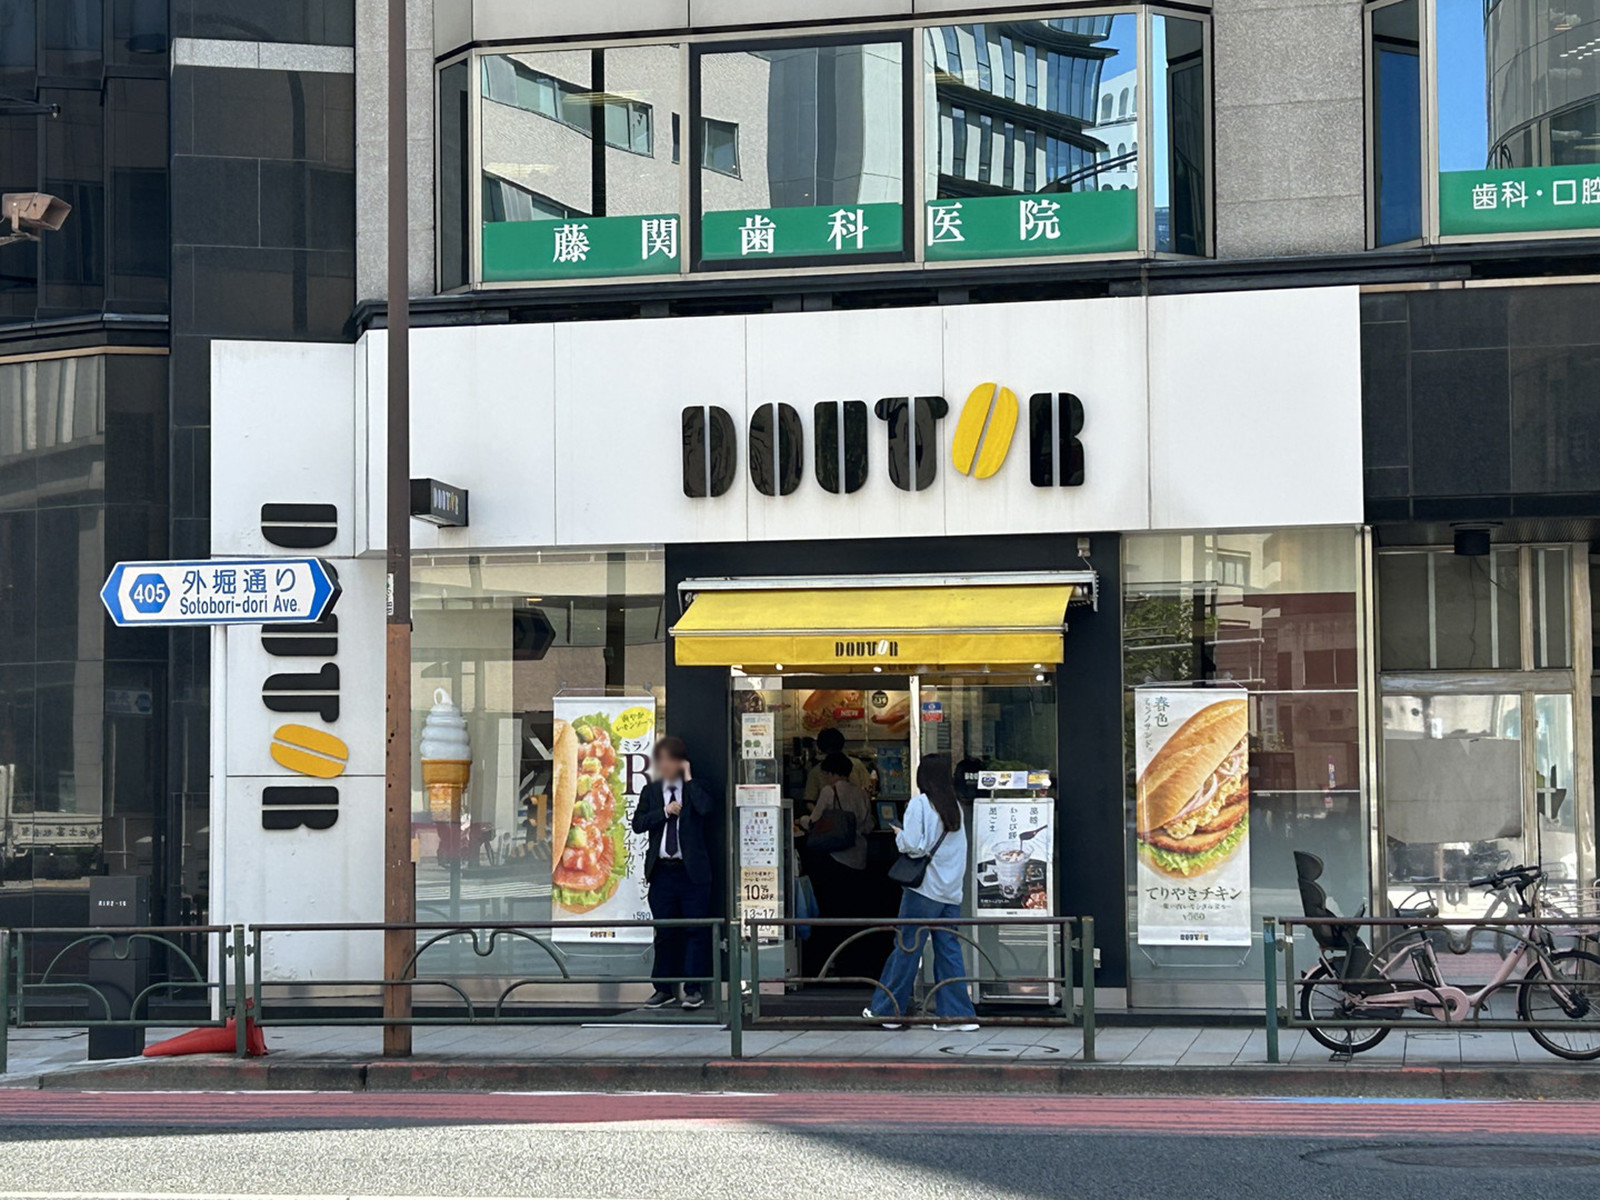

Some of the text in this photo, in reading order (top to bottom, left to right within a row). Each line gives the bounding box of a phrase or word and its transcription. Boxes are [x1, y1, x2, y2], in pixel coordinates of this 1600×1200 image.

[681, 382, 1085, 498] DOUTOR
[133, 583, 167, 604] 405
[182, 567, 297, 596] 外堀通り
[179, 594, 301, 615] Sotobori-dori Ave.
[835, 639, 898, 657] DOUTOR
[261, 503, 349, 830] DUTOR
[1153, 695, 1170, 728] 春色
[1146, 886, 1241, 901] てりやきチキン
